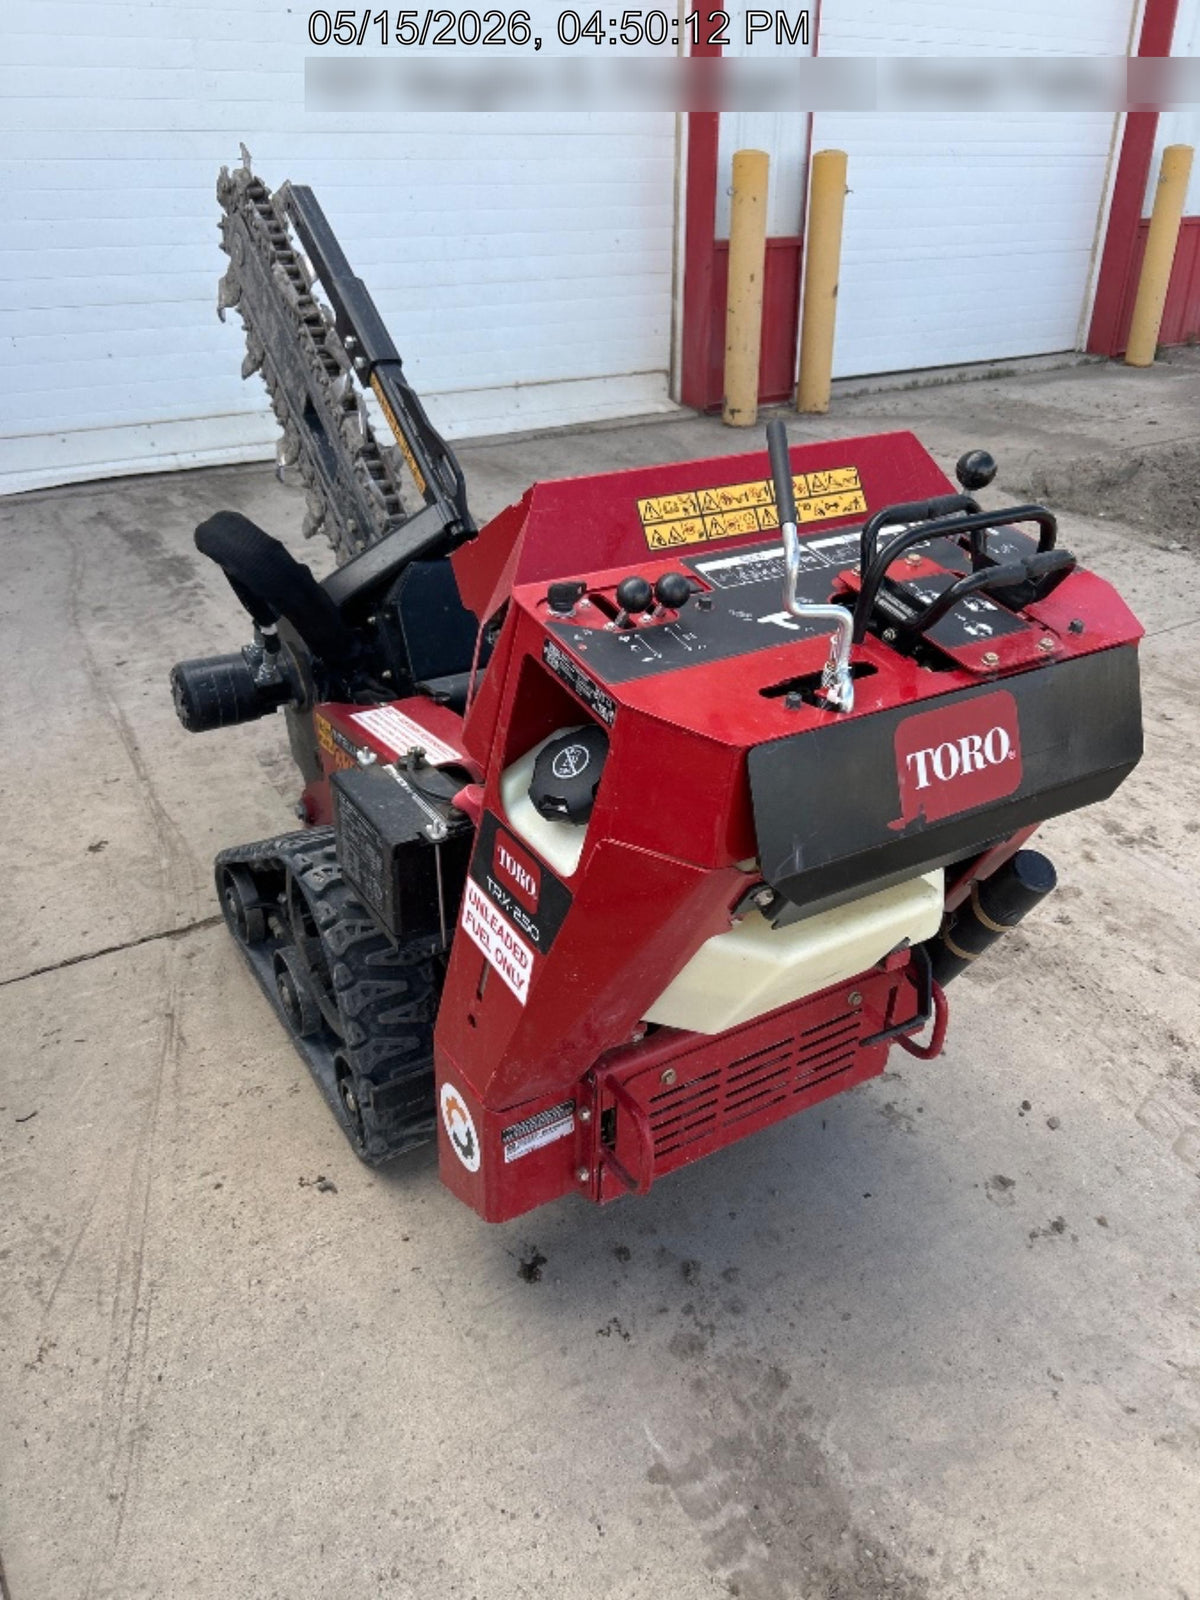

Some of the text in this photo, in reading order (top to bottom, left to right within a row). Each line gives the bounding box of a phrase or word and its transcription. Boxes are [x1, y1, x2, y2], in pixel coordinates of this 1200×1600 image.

[486, 875, 540, 942] TRX-250
[498, 847, 538, 898] TORO
[465, 909, 526, 990] FUEL ONLY
[469, 887, 529, 970] UNLEADED
